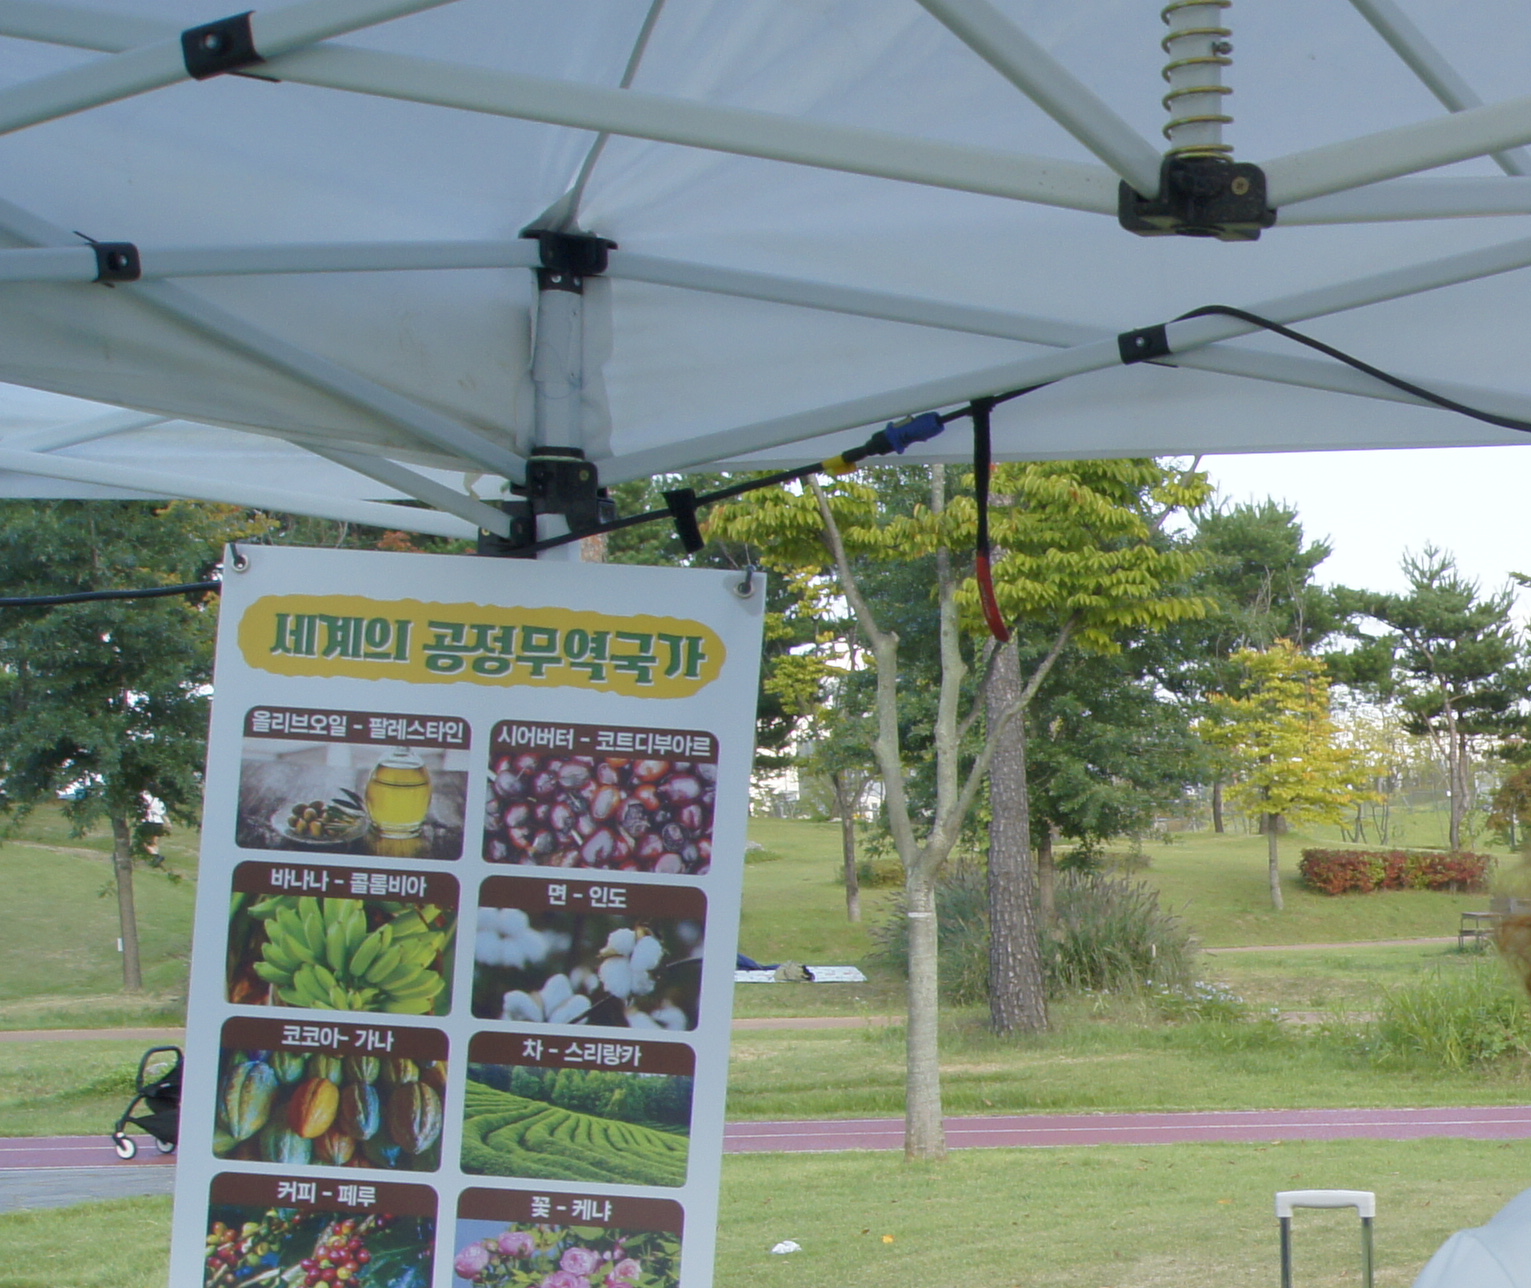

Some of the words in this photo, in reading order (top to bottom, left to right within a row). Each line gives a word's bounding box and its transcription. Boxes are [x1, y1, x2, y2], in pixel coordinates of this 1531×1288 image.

[269, 611, 413, 665] 세계의
[422, 619, 709, 686] 공정무역국가
[251, 709, 347, 739] 올리브오일
[367, 718, 464, 745] 팔레스타인
[497, 726, 575, 750] 시어버터
[595, 731, 712, 759] 코트디부아르
[270, 867, 330, 893] 바나나
[349, 871, 427, 899] 콜롬비아
[547, 883, 568, 908] 면
[588, 887, 628, 911] 인도
[354, 1028, 394, 1052] 가나
[523, 1039, 544, 1062] 차
[564, 1041, 642, 1067] 스리랑카
[277, 1181, 318, 1205] 커피
[337, 1185, 377, 1208] 페루
[530, 1196, 551, 1219] 꽃
[571, 1198, 613, 1222] 케냐
